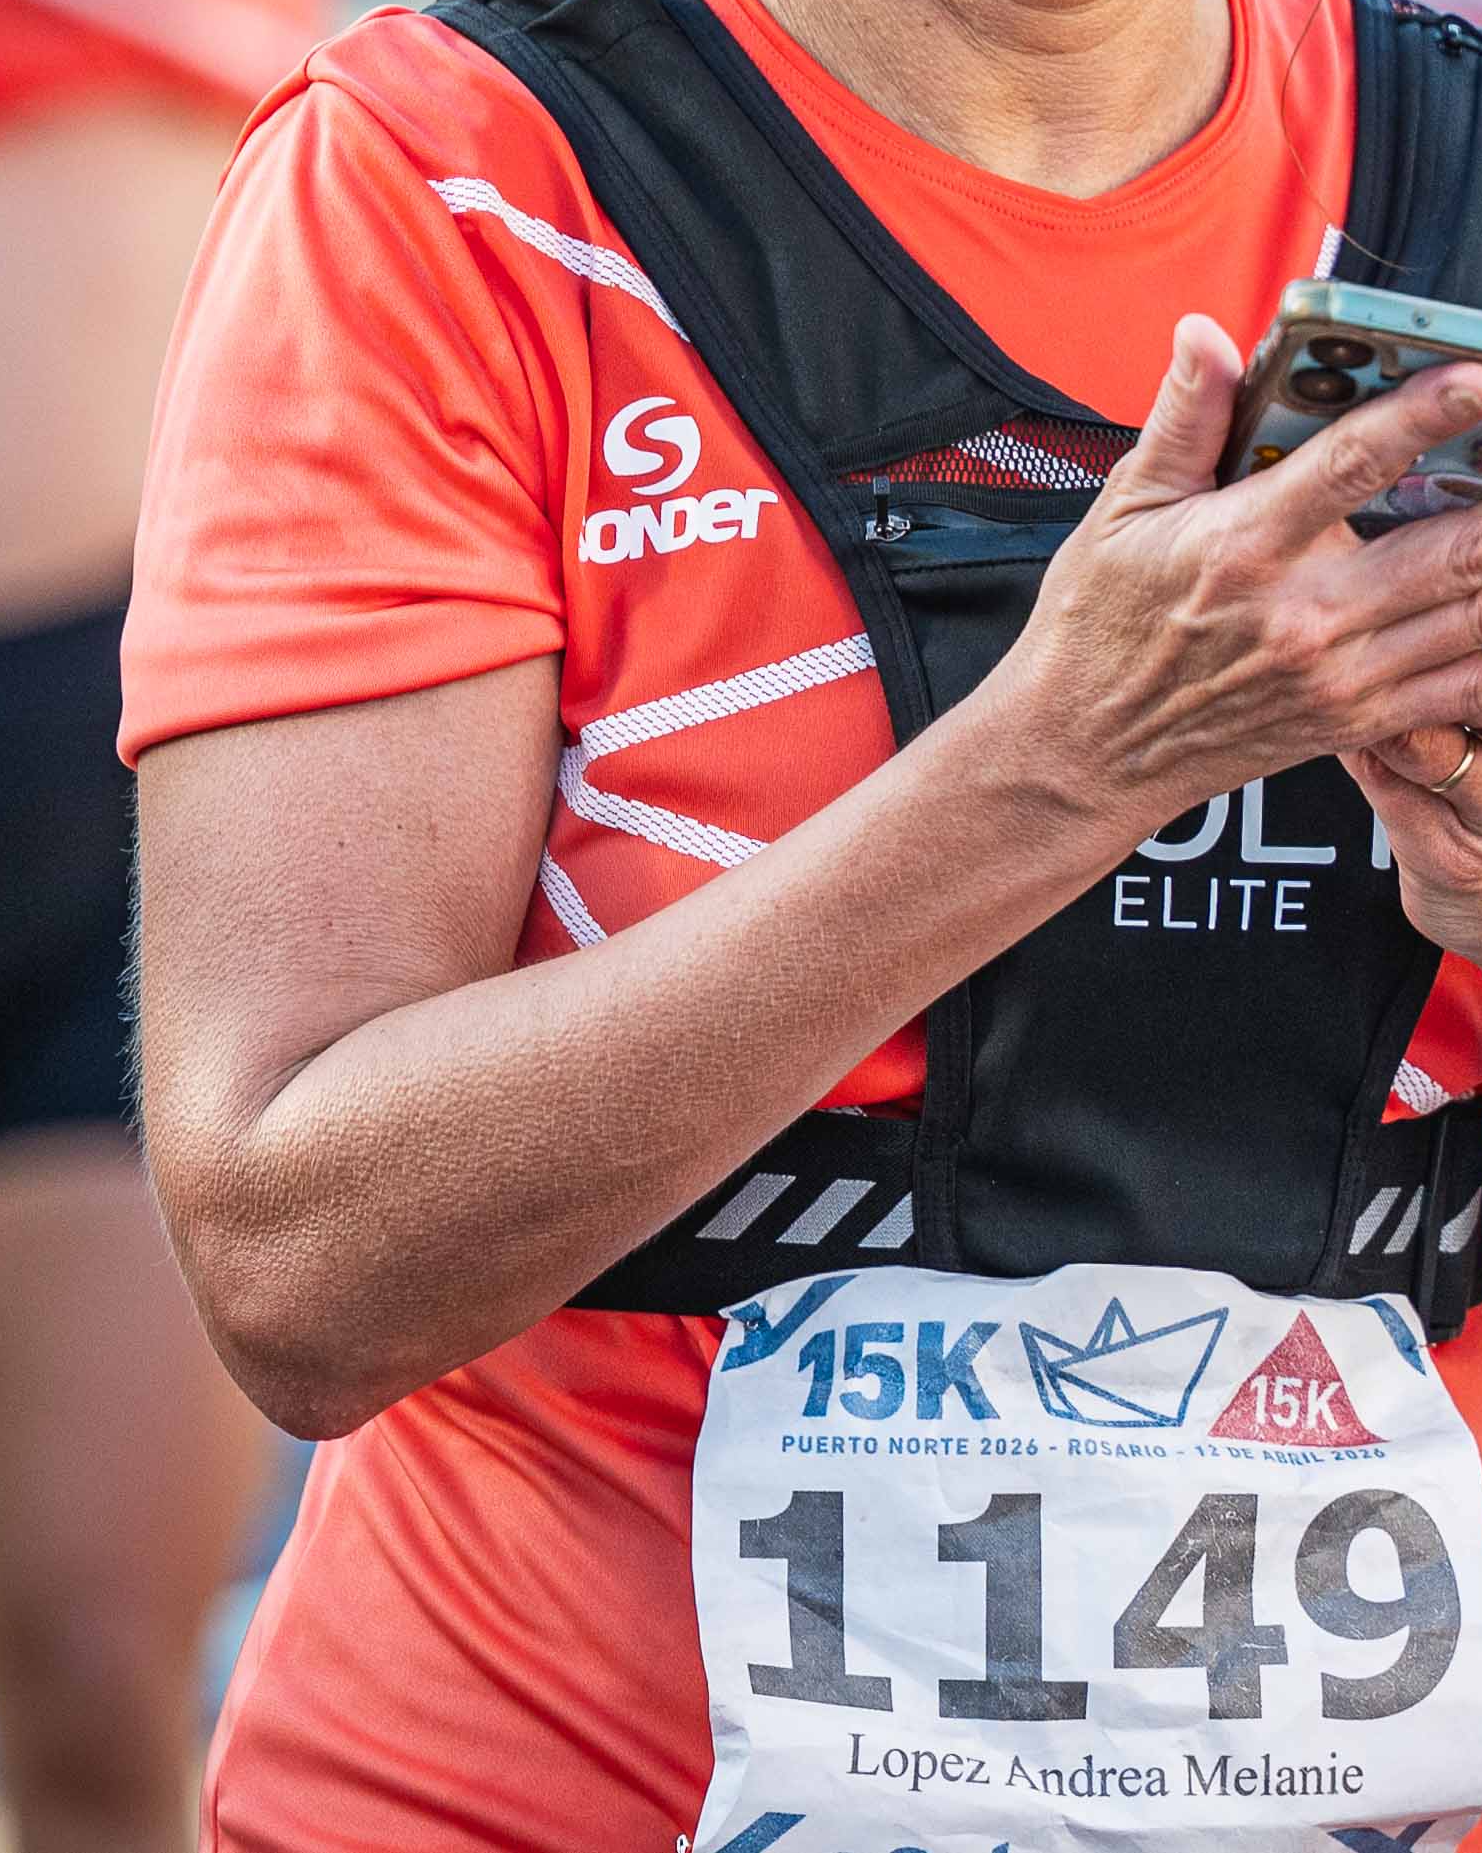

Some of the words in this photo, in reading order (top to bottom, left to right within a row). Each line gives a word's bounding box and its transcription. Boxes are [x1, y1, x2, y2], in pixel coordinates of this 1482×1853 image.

[1114, 875, 1311, 930] ELITE
[797, 1321, 1002, 1420] 15K
[1249, 1374, 1341, 1433] 15K
[781, 1435, 879, 1455] PUERTO
[889, 1437, 969, 1456] NORTE
[980, 1438, 1039, 1457] 2026
[1067, 1438, 1167, 1459] ROSARIO
[1230, 1446, 1254, 1460] DE
[1262, 1449, 1322, 1467] ABRIL
[1332, 1448, 1387, 1462] 2026
[739, 1489, 1461, 1722] 1149
[845, 1733, 991, 1793] Lopez
[1005, 1755, 1170, 1798] Andrea
[1183, 1751, 1364, 1797] Melanie
